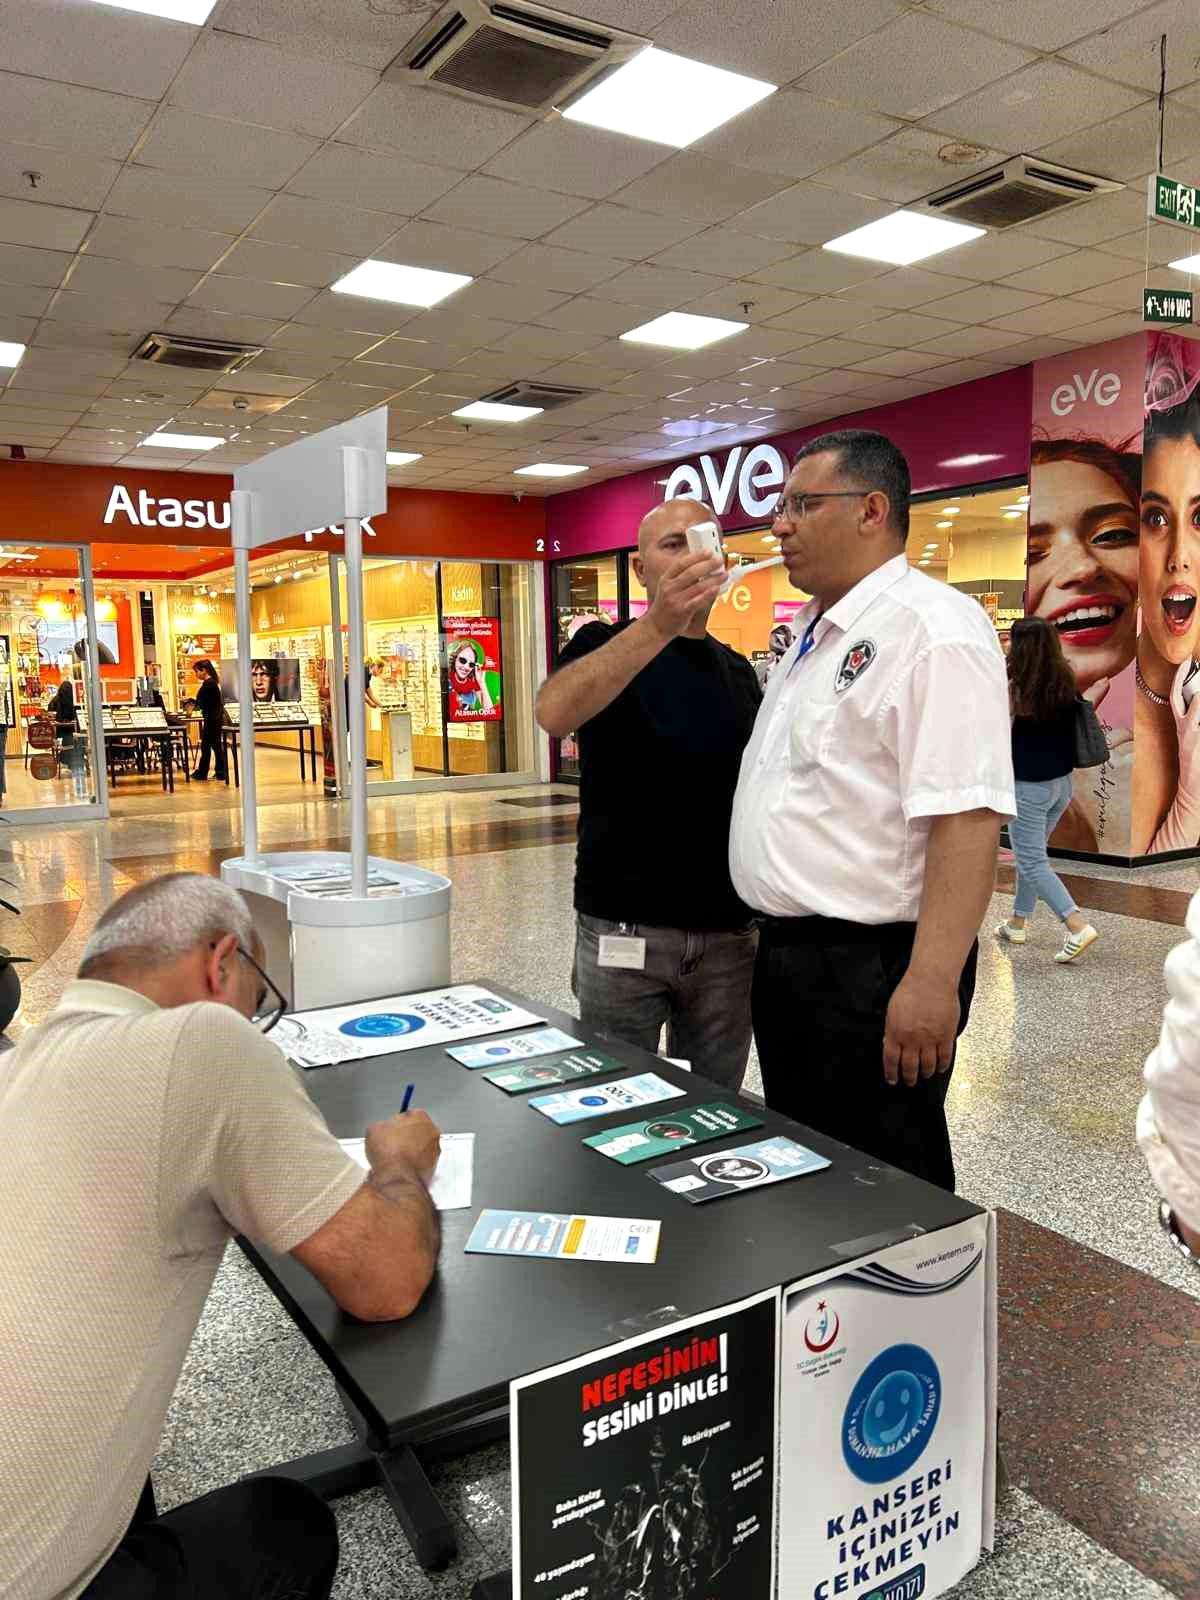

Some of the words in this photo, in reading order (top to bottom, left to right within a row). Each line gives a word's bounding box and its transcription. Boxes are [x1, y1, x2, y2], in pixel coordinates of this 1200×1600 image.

[1159, 187, 1177, 212] EXIT
[1176, 299, 1191, 318] WC
[1051, 368, 1121, 416] eve
[664, 443, 784, 518] eve
[103, 485, 231, 529] Atasu
[536, 539, 545, 552] 2
[916, 1242, 975, 1270] www.ketem.org
[581, 1336, 718, 1413] NEFESİNİN
[583, 1392, 653, 1447] SESİNİ
[827, 1459, 952, 1540] KANSERİ
[839, 1494, 942, 1564] İÇİNİZE
